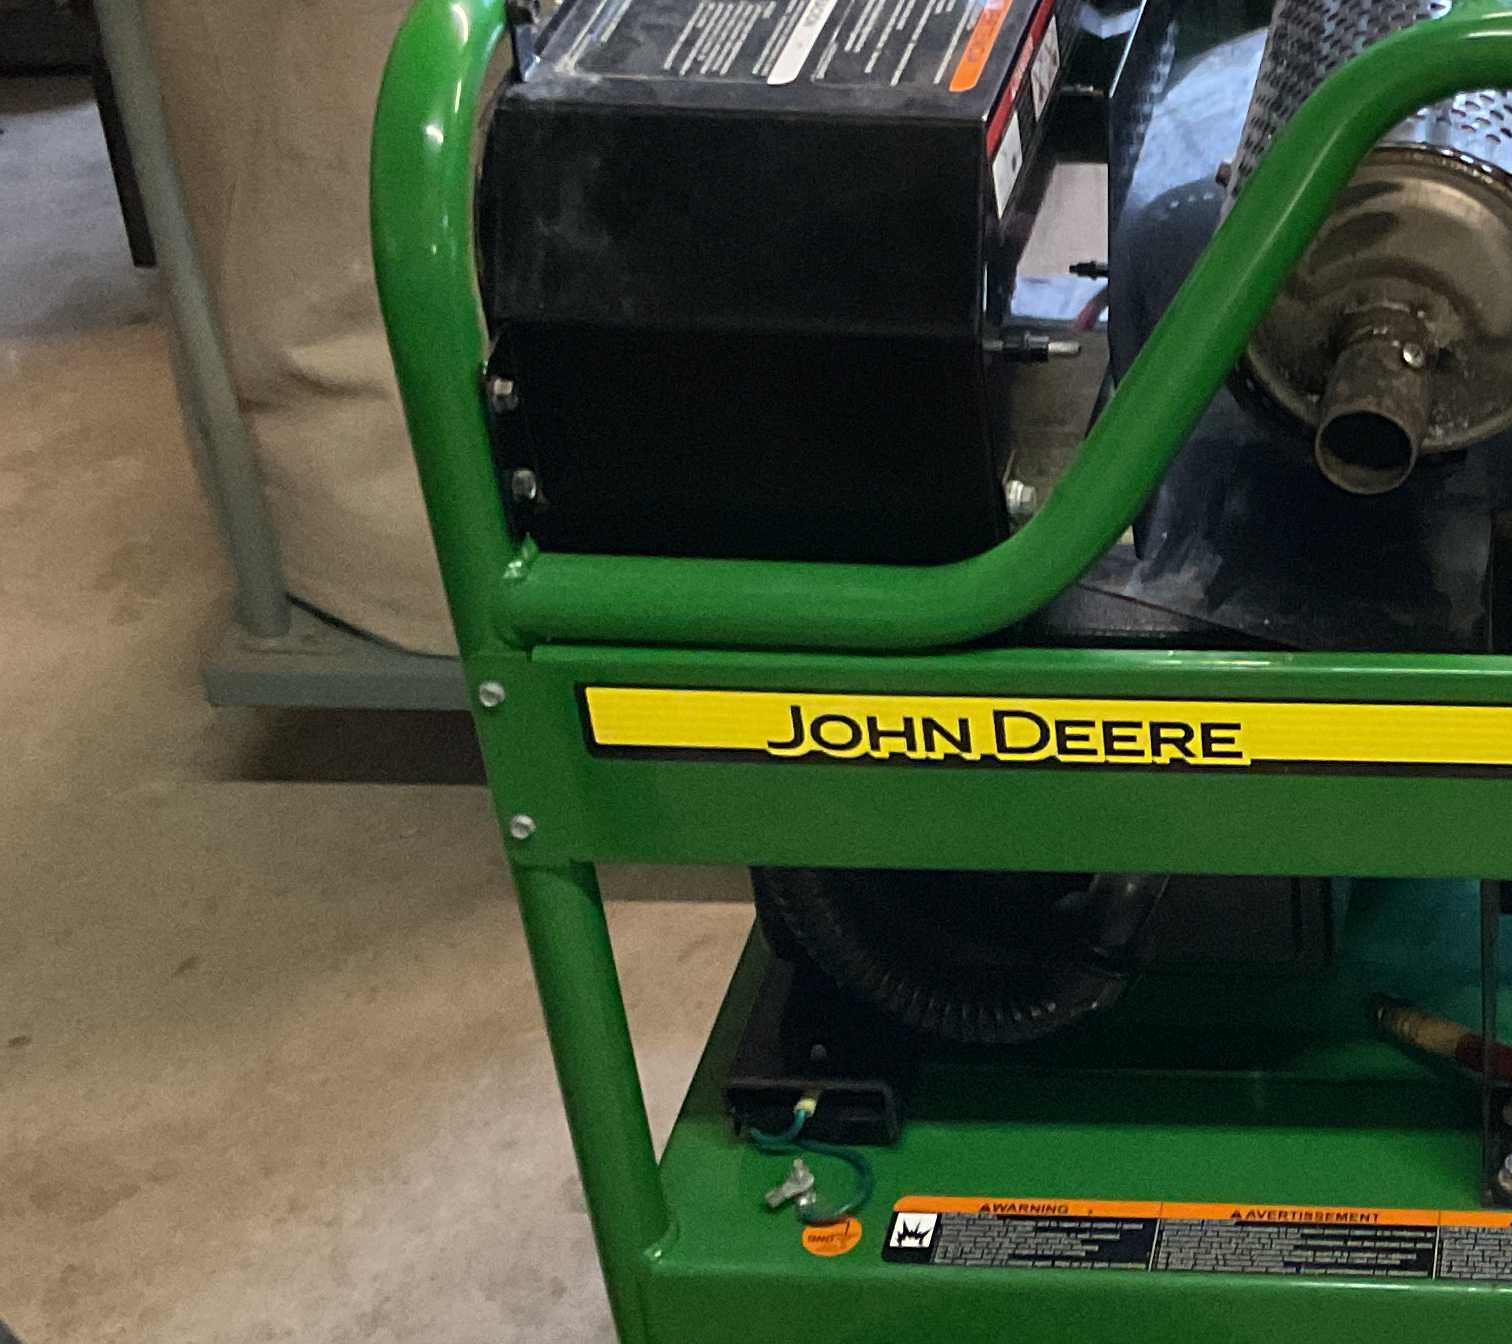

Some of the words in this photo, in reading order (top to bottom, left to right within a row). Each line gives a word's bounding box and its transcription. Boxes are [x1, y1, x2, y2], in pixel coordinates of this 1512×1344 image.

[767, 704, 972, 754] JOHN
[994, 709, 1244, 760] DEERE
[993, 1202, 1069, 1215] WARNING
[1245, 1209, 1381, 1223] AVERTISSEMENT
